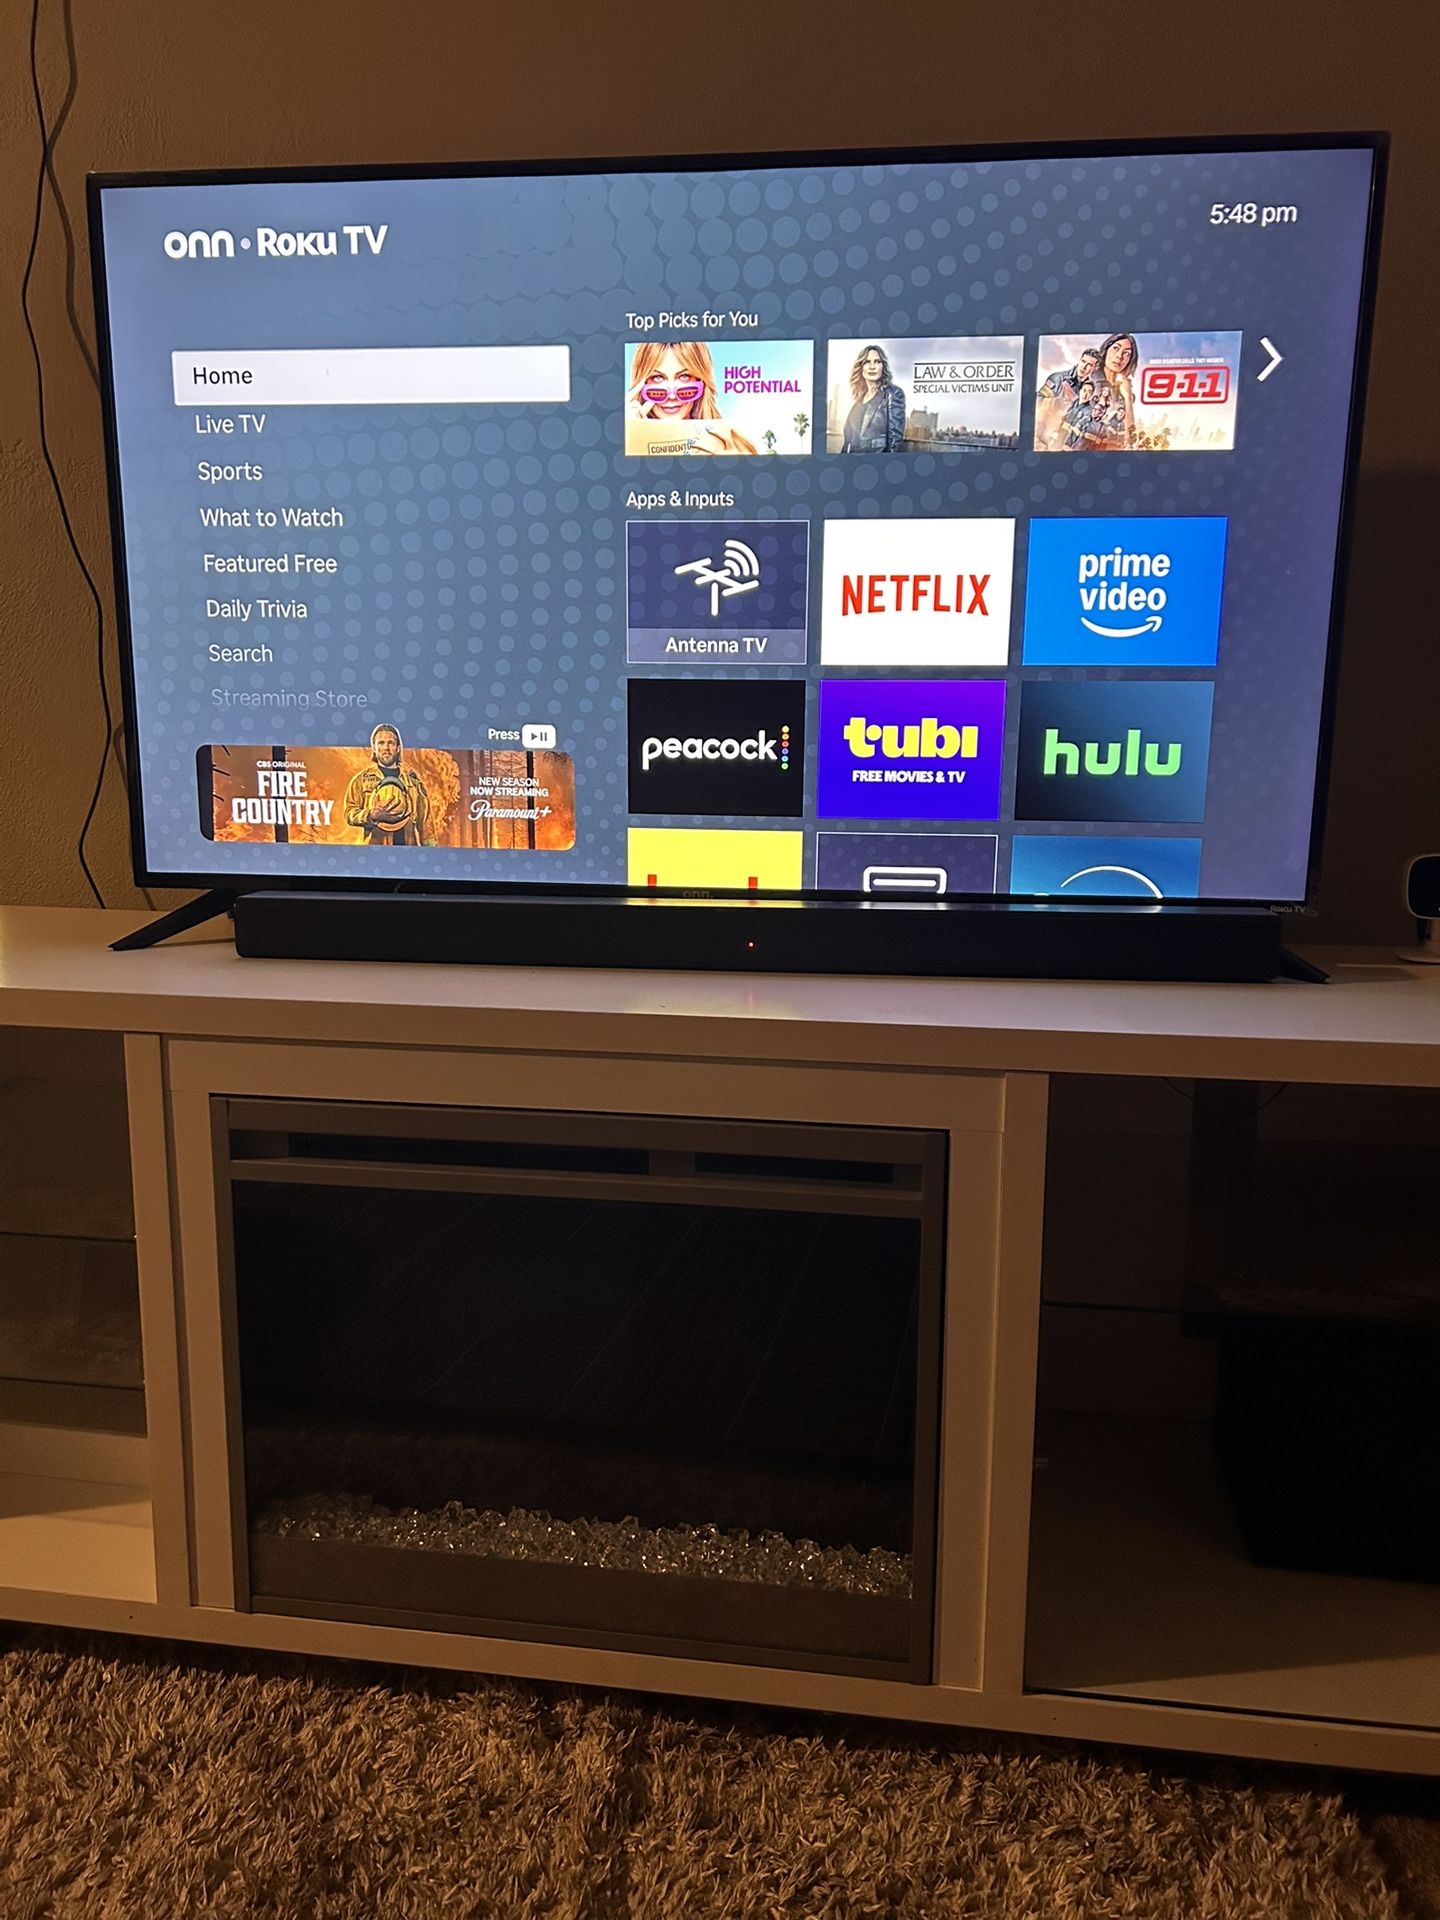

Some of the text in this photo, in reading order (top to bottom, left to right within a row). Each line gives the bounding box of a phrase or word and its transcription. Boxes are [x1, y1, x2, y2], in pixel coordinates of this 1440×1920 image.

[1209, 202, 1297, 227] 5:48 pm
[163, 225, 389, 259] onn Roku TV
[625, 310, 759, 332] Top Picks for You
[193, 367, 254, 386] Home
[724, 366, 761, 379] HIGH
[914, 365, 1013, 379] LAW & ORDER
[724, 380, 802, 394] POTENTIAL
[913, 383, 1014, 394] SPECIAL VICTIMS UNIT
[195, 414, 266, 435] Live TV
[197, 460, 264, 484] Sports
[626, 490, 735, 511] Apps & Inputs
[200, 507, 344, 528] What to Watch
[203, 554, 339, 574] Featured Free
[1078, 546, 1171, 584] prime
[843, 574, 990, 617] NETFLIX
[1080, 581, 1167, 612] video
[206, 599, 309, 622] Daily Trivia
[208, 644, 274, 664] Search
[665, 636, 768, 655] Antenna TV
[211, 688, 369, 711] Streaming Store
[487, 727, 521, 742] Press
[642, 729, 779, 771] peacock
[1042, 729, 1182, 778] hulu
[256, 760, 307, 769] CBS ORIGINAL
[256, 770, 309, 798] FIRE
[478, 777, 540, 787] NEW SEASON
[852, 770, 967, 784] FREE MOVIES & TV
[469, 786, 549, 797] NOW STREAMING
[231, 797, 335, 827] COUNTRY
